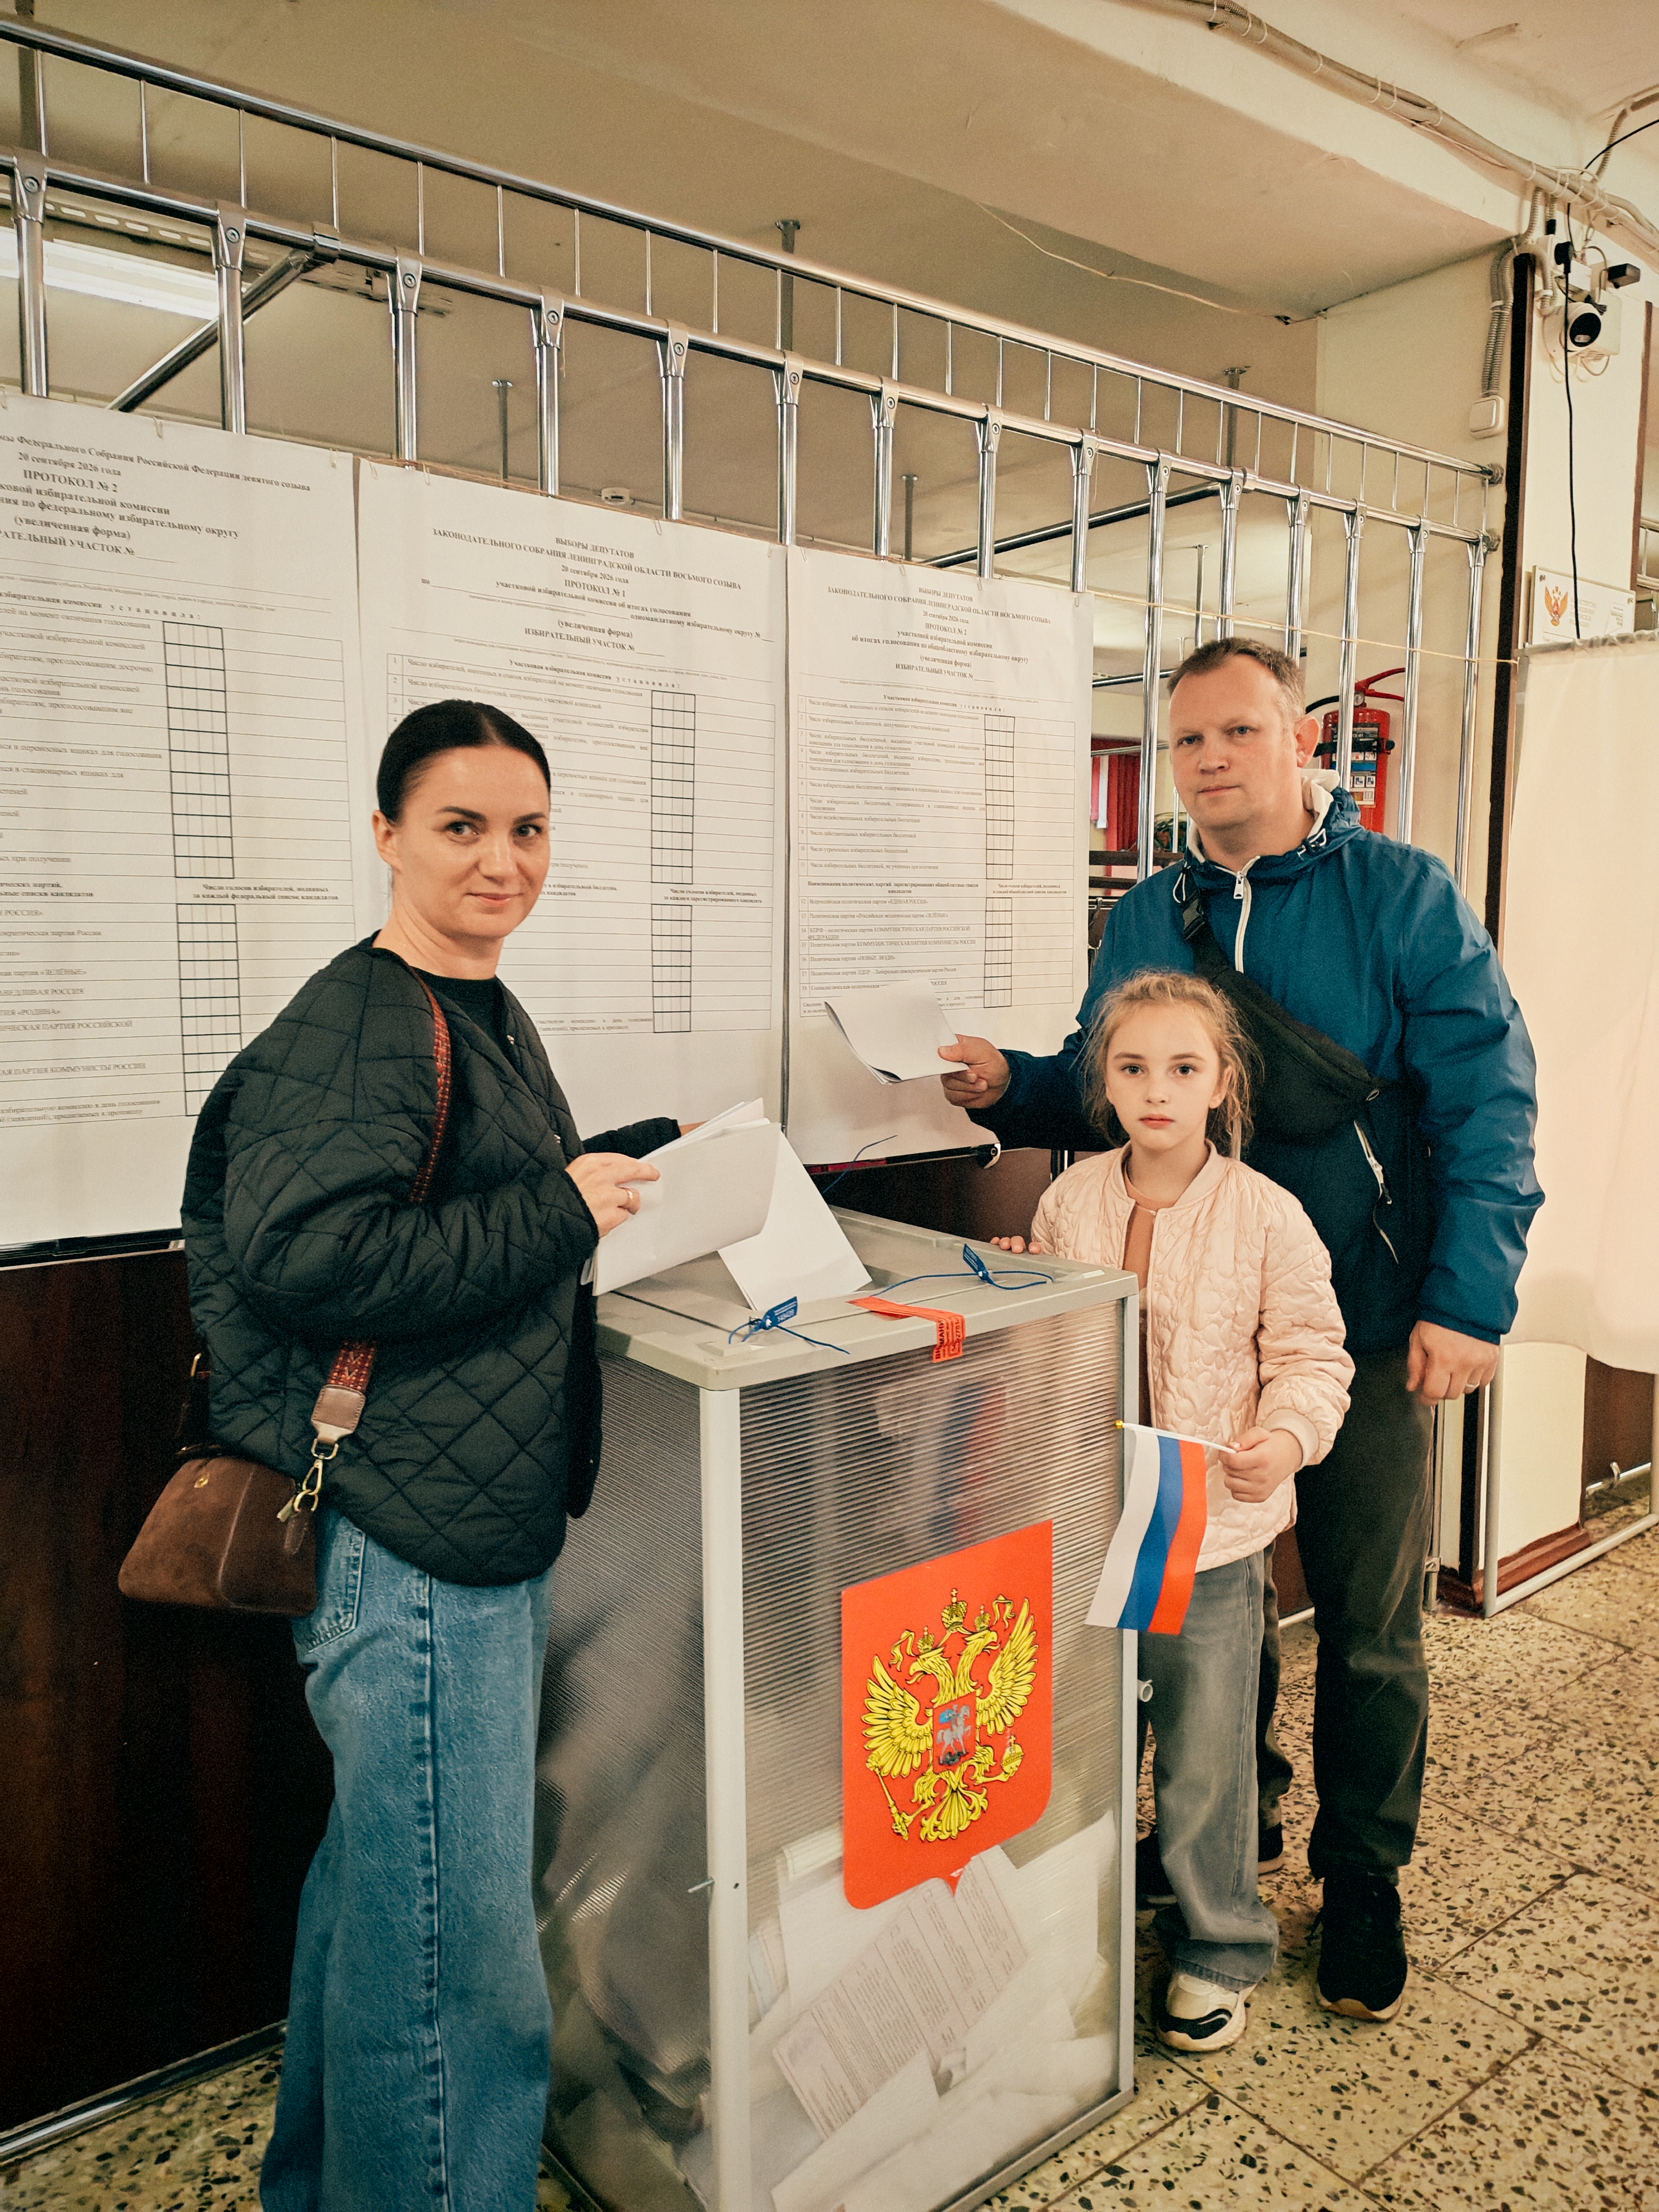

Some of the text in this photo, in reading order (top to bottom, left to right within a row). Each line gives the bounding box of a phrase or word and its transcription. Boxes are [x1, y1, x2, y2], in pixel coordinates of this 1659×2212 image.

[17, 436, 86, 454] Федерального
[89, 448, 134, 462] Собрания
[137, 456, 188, 471] Российской
[192, 465, 240, 480] Федерации
[242, 475, 279, 485] девятого
[281, 482, 310, 491] созыва
[18, 452, 122, 476] 20 сентября 2026 года
[23, 470, 118, 492] ПРОТОКОЛ № 2
[36, 489, 117, 507] избирательной
[120, 502, 170, 515] комиссии
[14, 517, 131, 539] (увеличенная форма)
[38, 500, 115, 521] федеральному
[119, 514, 203, 534] избирательному
[205, 528, 239, 539] округу
[69, 539, 123, 554] УЧАСТОК
[124, 547, 135, 555] №
[555, 537, 635, 558] ВЫБОРЫ ДЕПУТАТОВ
[432, 529, 741, 589] ЗАКОНОДАТЕЛЬНОГО СОБРАНИЯ ЛЕНИНГРАДСКОЙ ОБЛАСТИ ВОСЬМОГО СОЗЫВА
[564, 579, 610, 595] ПРОТОКОЛ
[918, 587, 973, 602] ВЫБОРЫ ДЕПУТАТОВ
[827, 586, 893, 601] ЗАКОНОДАТЕЛЬНОГО
[894, 596, 926, 605] СОБРАНИЯ
[927, 601, 972, 613] ЛЕНИНГРАДСКОЙ
[973, 609, 999, 617] ОБЛАСТИ
[1000, 612, 1030, 621] ВОСЬМОГО
[524, 628, 591, 644] ИЗБИРАТЕЛЬНЫЙ
[592, 639, 626, 650] УЧАСТОК
[557, 620, 633, 638] (увеличенная форма)
[896, 631, 929, 639] участковой
[925, 623, 955, 633] ПРОТОКОЛ
[895, 664, 942, 675] ИЗБИРАТЕЛЬНЫЙ
